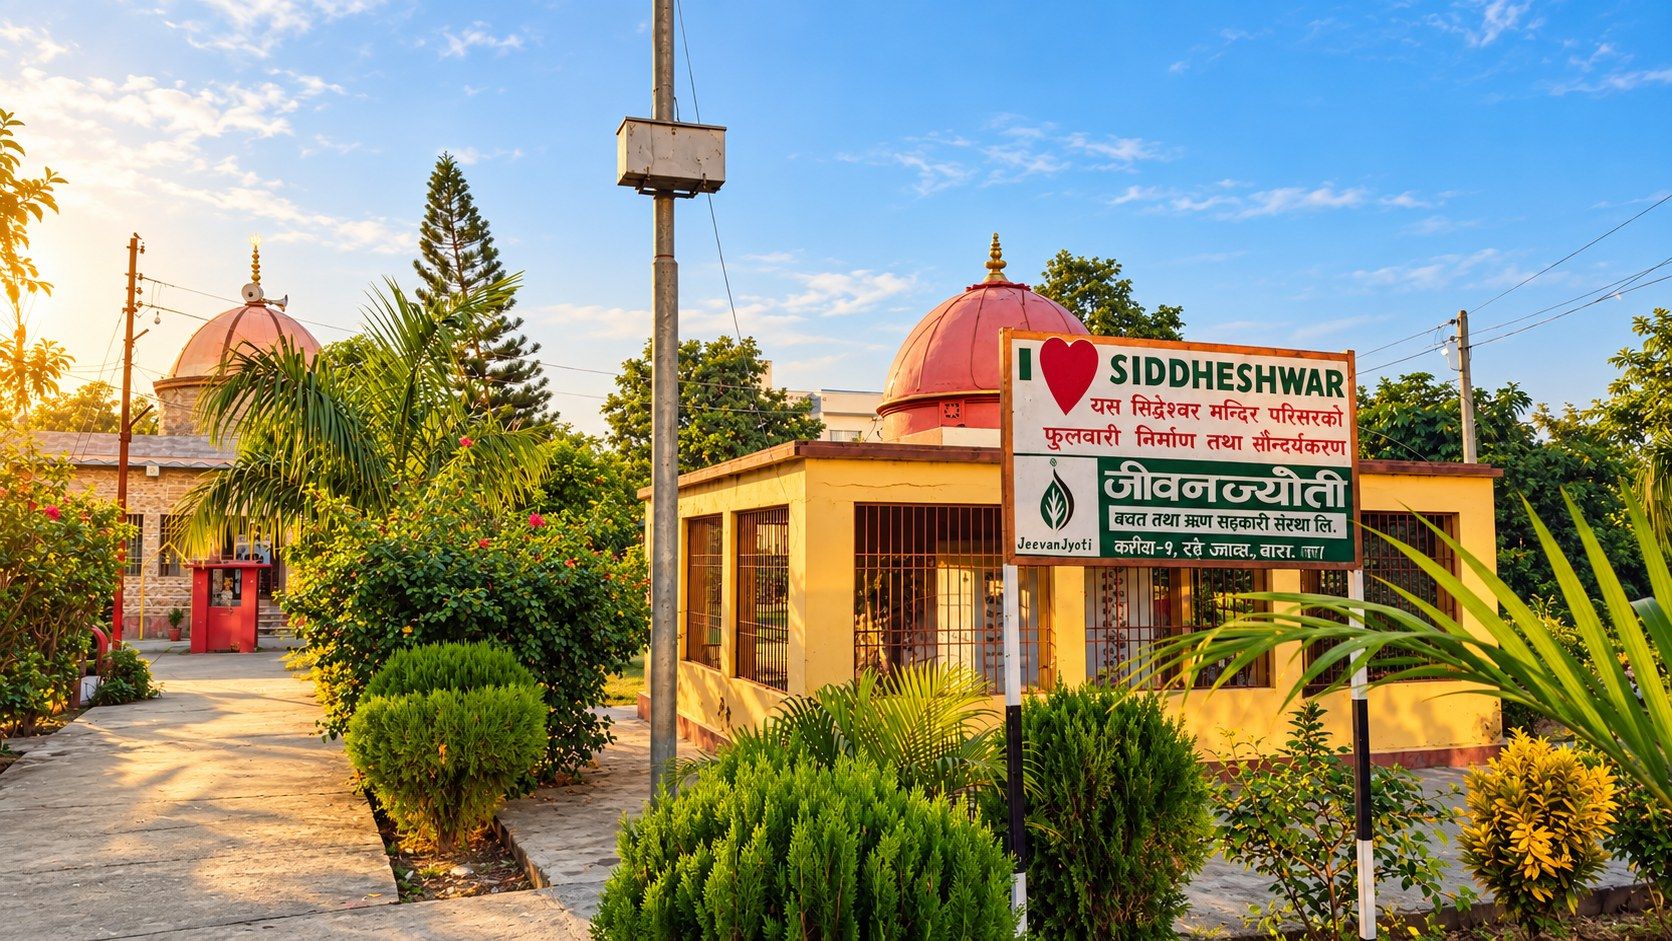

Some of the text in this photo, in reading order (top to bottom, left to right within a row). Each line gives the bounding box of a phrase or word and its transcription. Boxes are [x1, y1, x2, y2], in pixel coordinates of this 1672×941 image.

[1019, 348, 1344, 398] I SIDDHESHWAR
[1091, 397, 1121, 415] यस
[1210, 398, 1261, 423] मन्दिर
[1268, 402, 1345, 427] परिसरको
[1043, 424, 1120, 450] फुलवारी
[1135, 425, 1196, 448] निर्माण
[1207, 434, 1243, 450] तथा
[1152, 513, 1181, 527] तथा
[1314, 514, 1336, 533] लि.
[1017, 537, 1092, 553] JeevanJyoti
